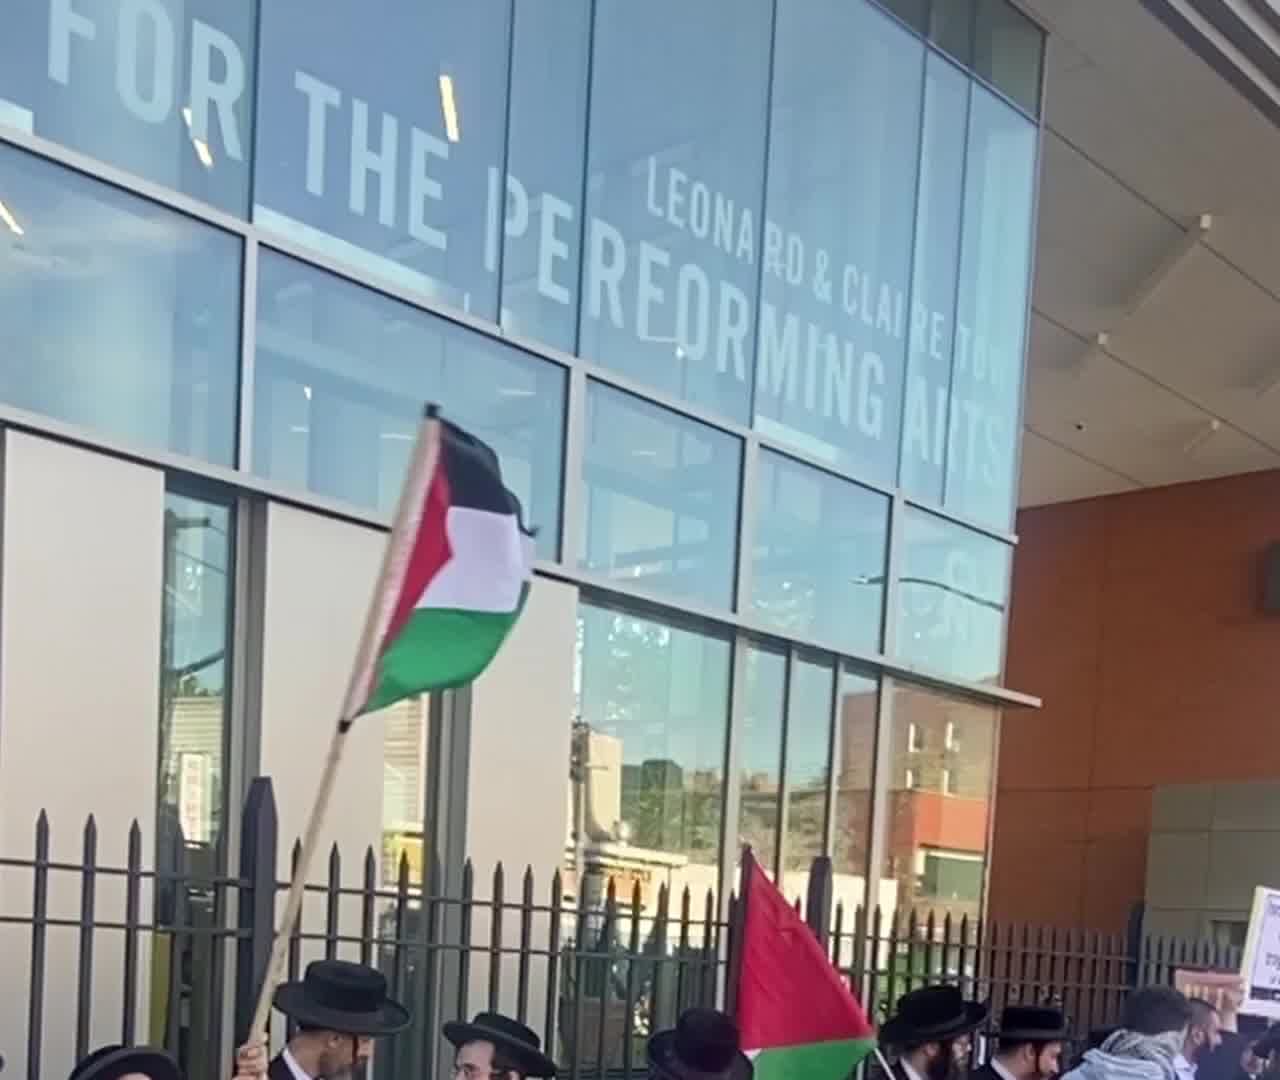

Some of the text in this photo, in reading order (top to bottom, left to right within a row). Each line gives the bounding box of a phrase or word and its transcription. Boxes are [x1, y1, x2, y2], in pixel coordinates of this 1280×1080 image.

[48, 0, 244, 161] FOR
[295, 70, 450, 250] THE
[647, 156, 804, 287] LEONARD
[815, 247, 834, 303] &
